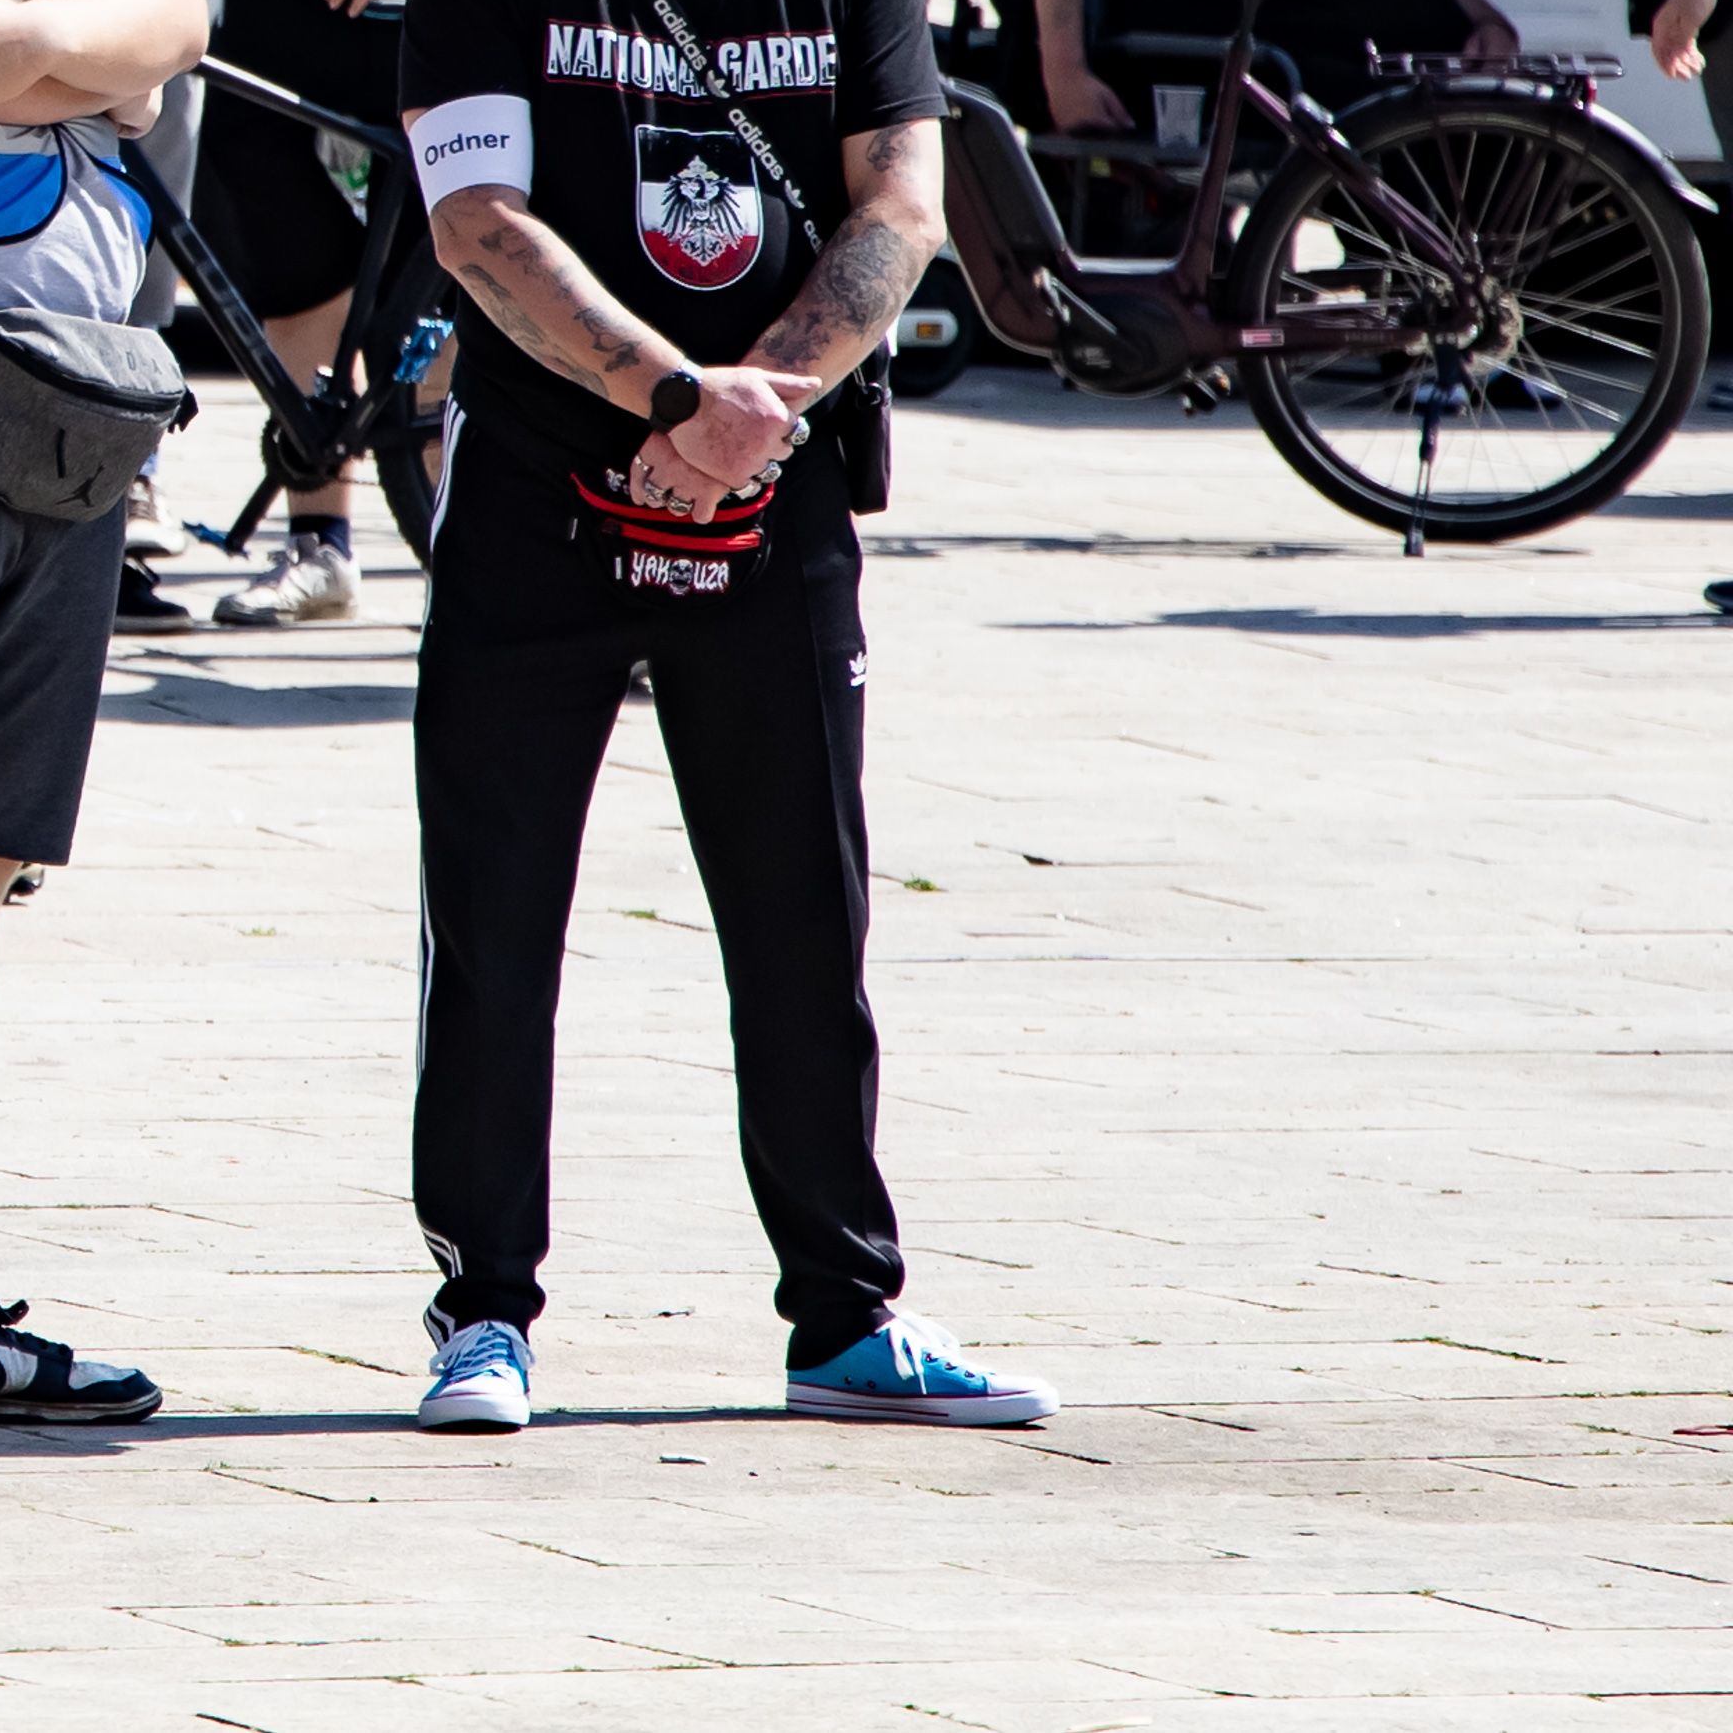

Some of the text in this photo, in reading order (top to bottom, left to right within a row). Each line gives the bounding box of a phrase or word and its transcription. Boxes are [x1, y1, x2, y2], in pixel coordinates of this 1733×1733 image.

[546, 23, 836, 98] NATIONA GARDE
[425, 130, 511, 167] Ordner
[729, 108, 784, 181] adidas
